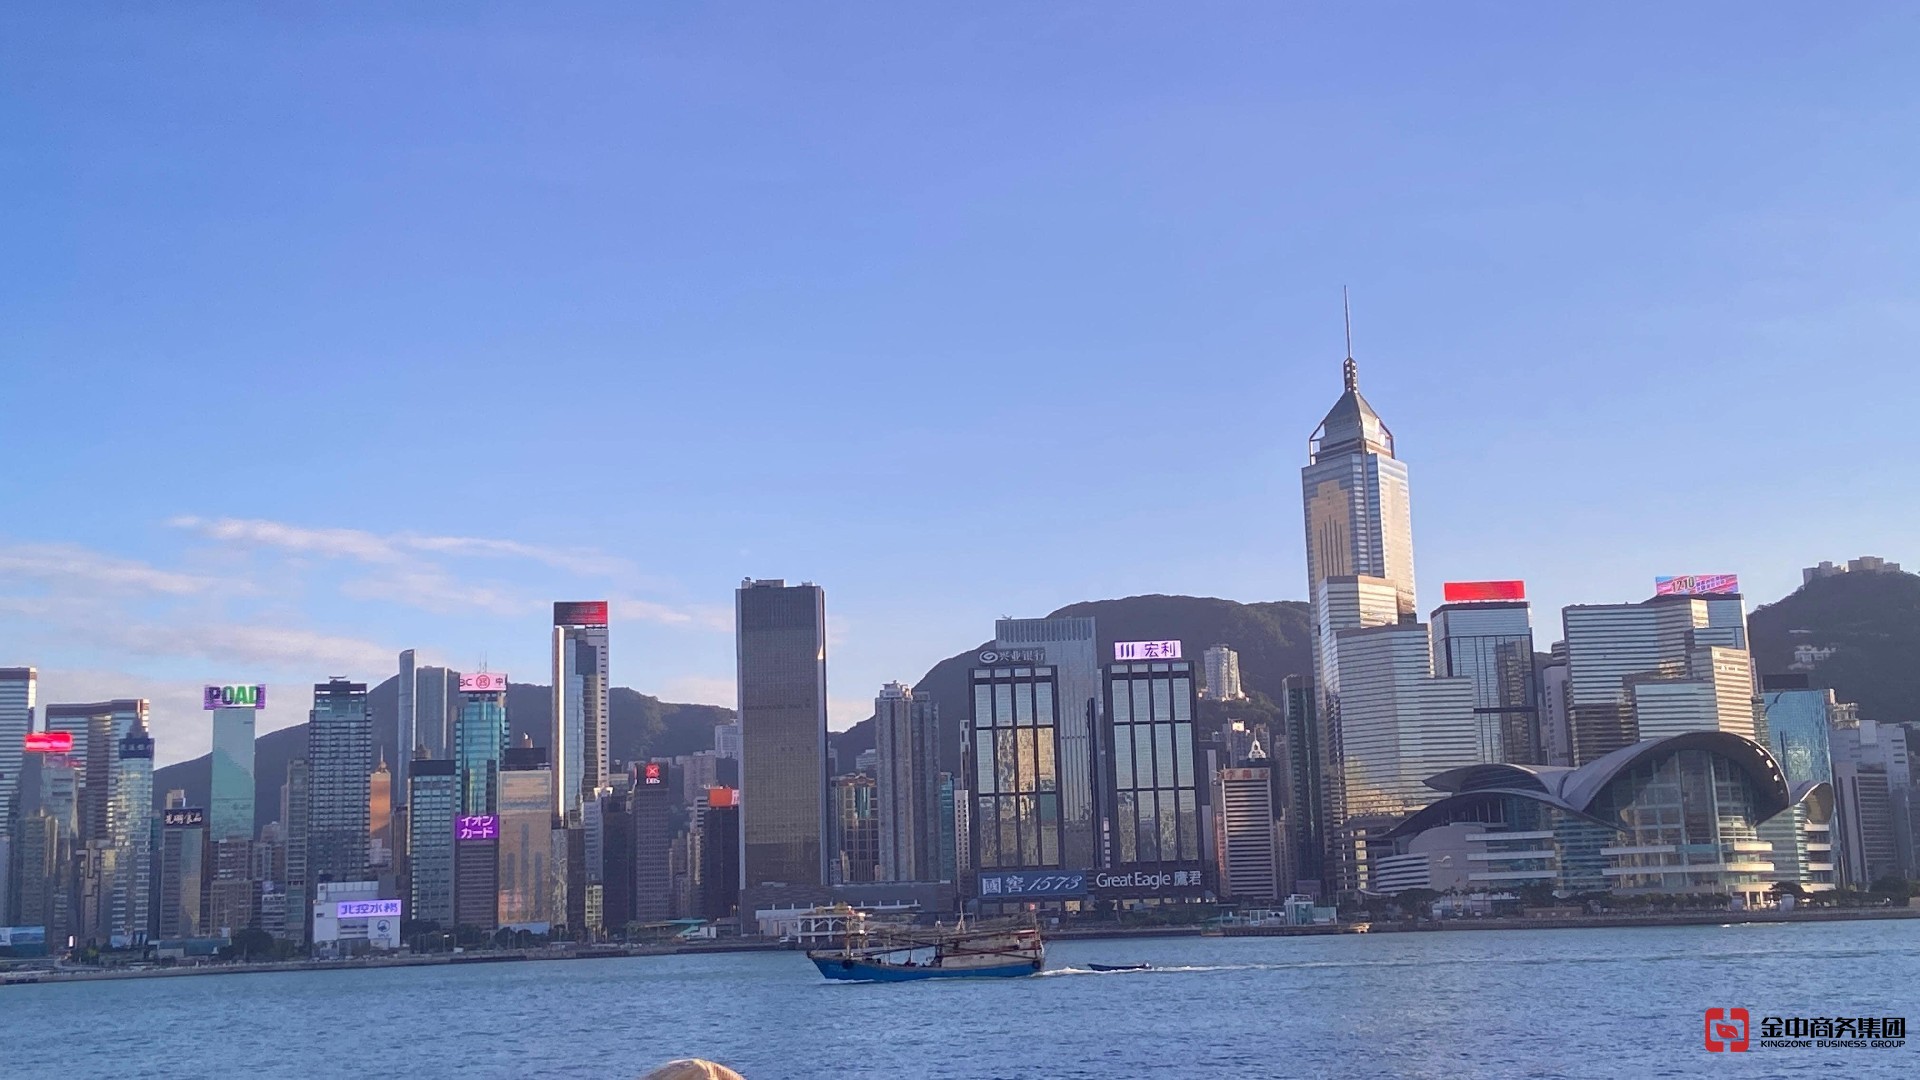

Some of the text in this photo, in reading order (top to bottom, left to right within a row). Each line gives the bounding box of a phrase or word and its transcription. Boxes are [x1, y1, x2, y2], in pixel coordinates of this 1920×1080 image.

[1000, 650, 1044, 662] 兴业银行
[1144, 642, 1176, 657] 宏利
[208, 685, 261, 705] POAD
[461, 816, 493, 826] イオン
[461, 827, 493, 839] カード
[1027, 875, 1083, 890] 1573
[1096, 872, 1134, 887] Great
[1134, 870, 1171, 889] Eagle
